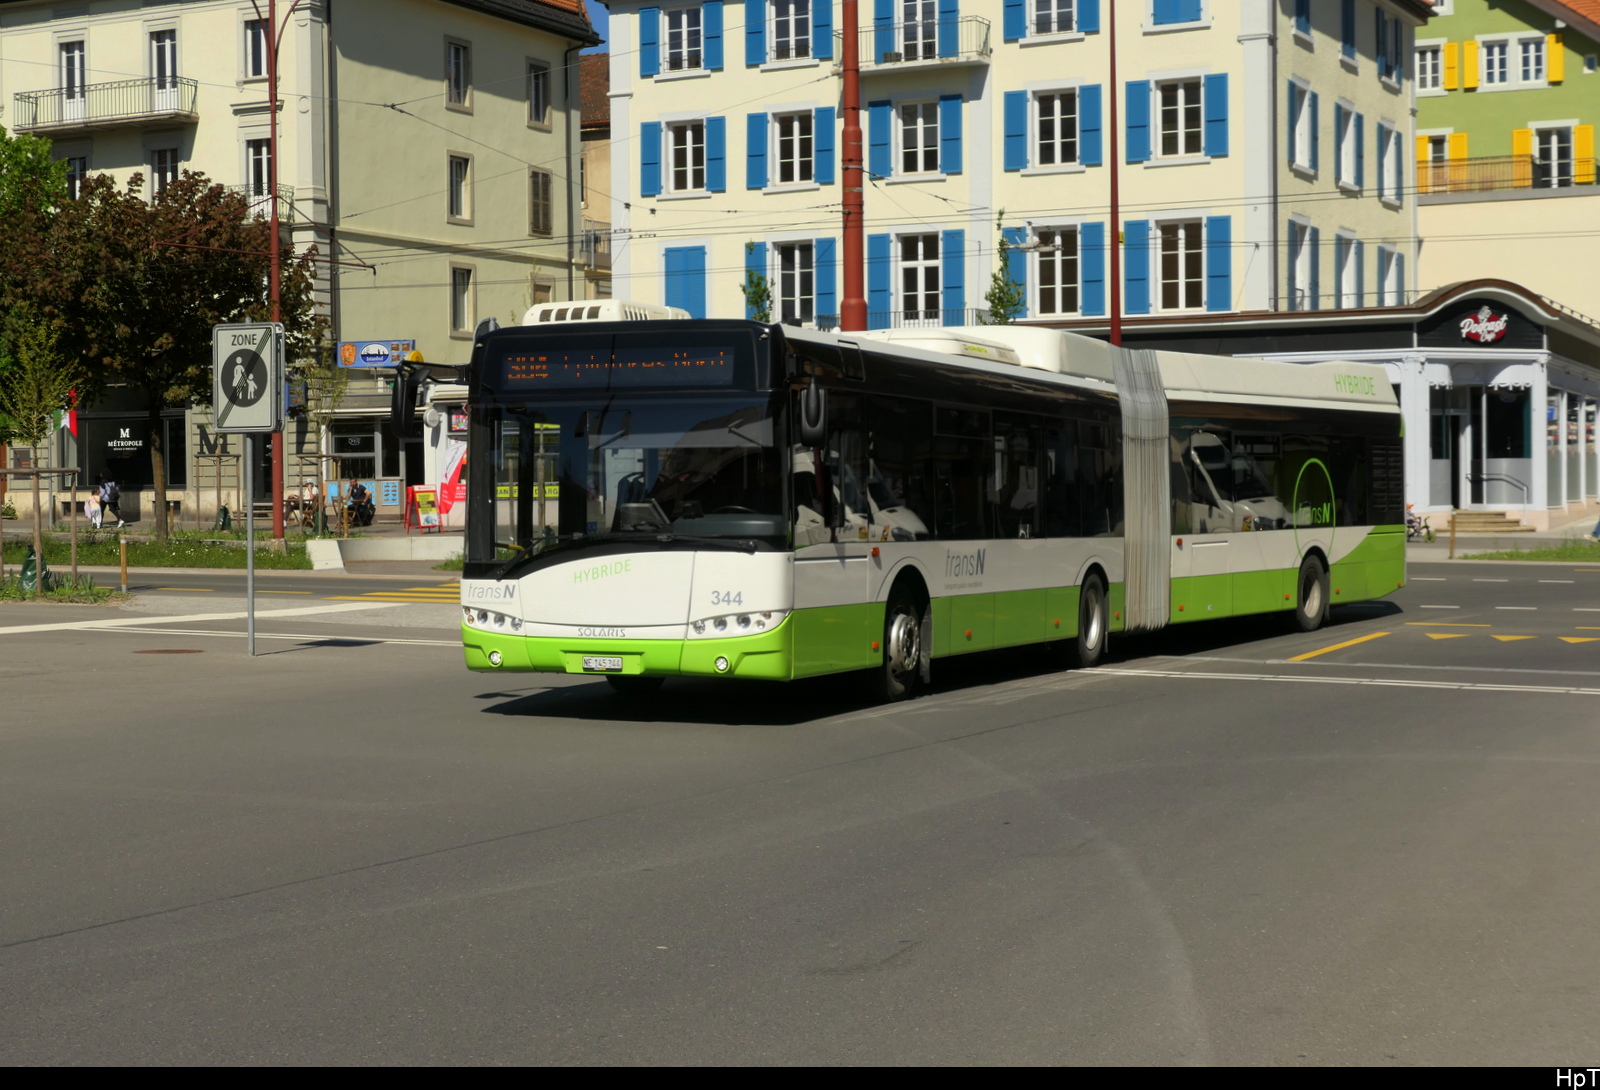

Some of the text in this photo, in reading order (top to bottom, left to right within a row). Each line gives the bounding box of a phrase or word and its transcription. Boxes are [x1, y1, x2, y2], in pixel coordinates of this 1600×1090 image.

[1460, 314, 1508, 338] Podcast
[231, 334, 257, 346] ZONE
[1334, 373, 1376, 396] HYBRIDE
[120, 428, 130, 438] M
[1299, 502, 1331, 524] transN
[573, 559, 632, 584] HYBRIDE
[944, 548, 986, 577] transN
[467, 583, 516, 599] transN
[711, 590, 743, 606] 344
[577, 627, 626, 637] SOLARIS
